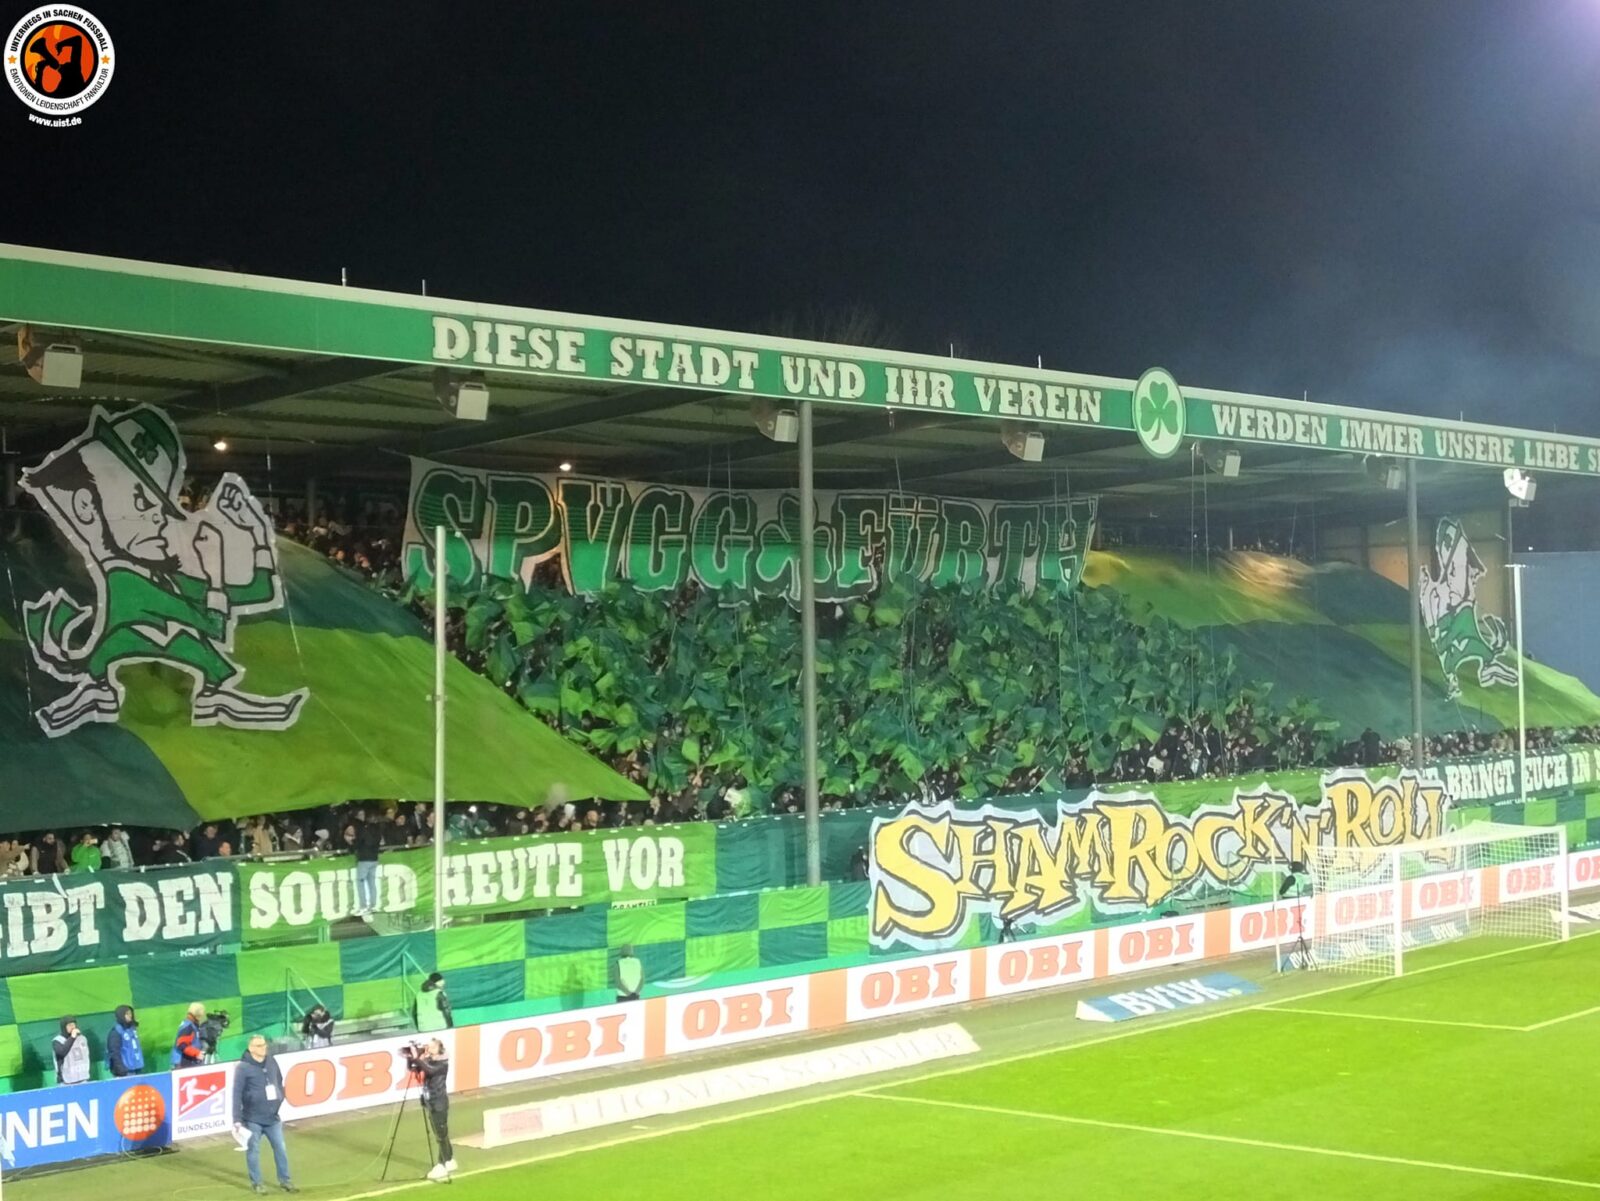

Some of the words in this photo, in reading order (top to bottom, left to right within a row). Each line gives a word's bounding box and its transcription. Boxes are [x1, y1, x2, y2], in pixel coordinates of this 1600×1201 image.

[432, 315, 586, 373] DIESE
[610, 336, 759, 390] STADT
[780, 354, 867, 399] UND
[885, 366, 956, 409] IHR
[974, 376, 1101, 423] VEREIN
[1211, 403, 1329, 446] WERDEN
[1340, 418, 1425, 456] IMMER
[1434, 429, 1516, 465] UNSERE
[1523, 440, 1580, 471] LIEBE
[1587, 447, 1600, 473] S
[1445, 759, 1516, 800] BRINGT
[1524, 753, 1569, 792] EUCH
[1568, 750, 1591, 784] IN
[0, 882, 105, 958] IBT
[117, 871, 234, 942] DEN
[441, 842, 583, 908] HEUTE
[602, 836, 685, 892] VOR
[1419, 876, 1473, 911] OBI
[1506, 862, 1555, 895] OBI
[1239, 904, 1307, 944] OBI
[1335, 889, 1394, 926] OBI
[998, 940, 1083, 986] OBI
[1119, 922, 1195, 964] OBI
[860, 960, 958, 1010] OBI
[682, 986, 794, 1041] OBI
[498, 1013, 628, 1072] OBI
[0, 1098, 99, 1150] NEN
[178, 1119, 226, 1134] BUNDESLIGA
